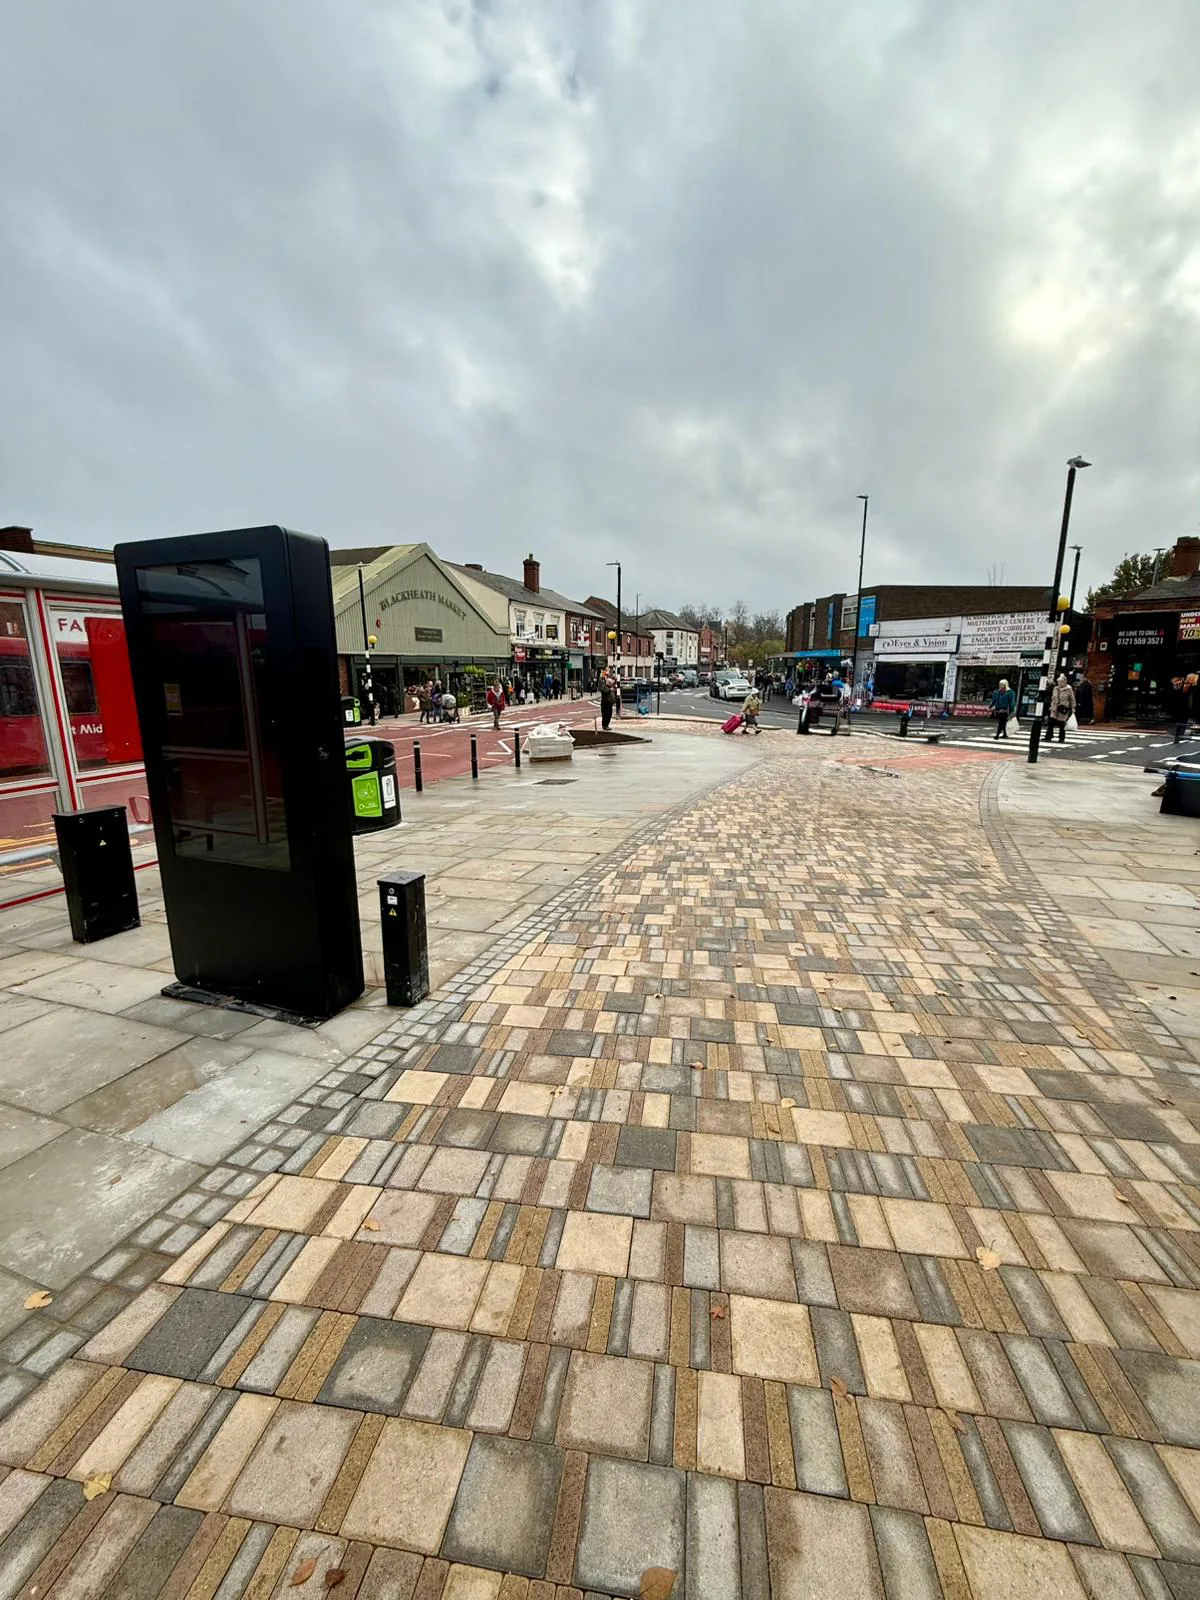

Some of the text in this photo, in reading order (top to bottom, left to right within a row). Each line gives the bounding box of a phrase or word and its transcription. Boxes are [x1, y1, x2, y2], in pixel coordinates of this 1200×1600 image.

[379, 589, 467, 620] BLACKHEATH MARKET
[967, 618, 1008, 626] MULTISERVICE
[894, 638, 948, 648] Eyes & Vision
[80, 724, 103, 734] Mid
